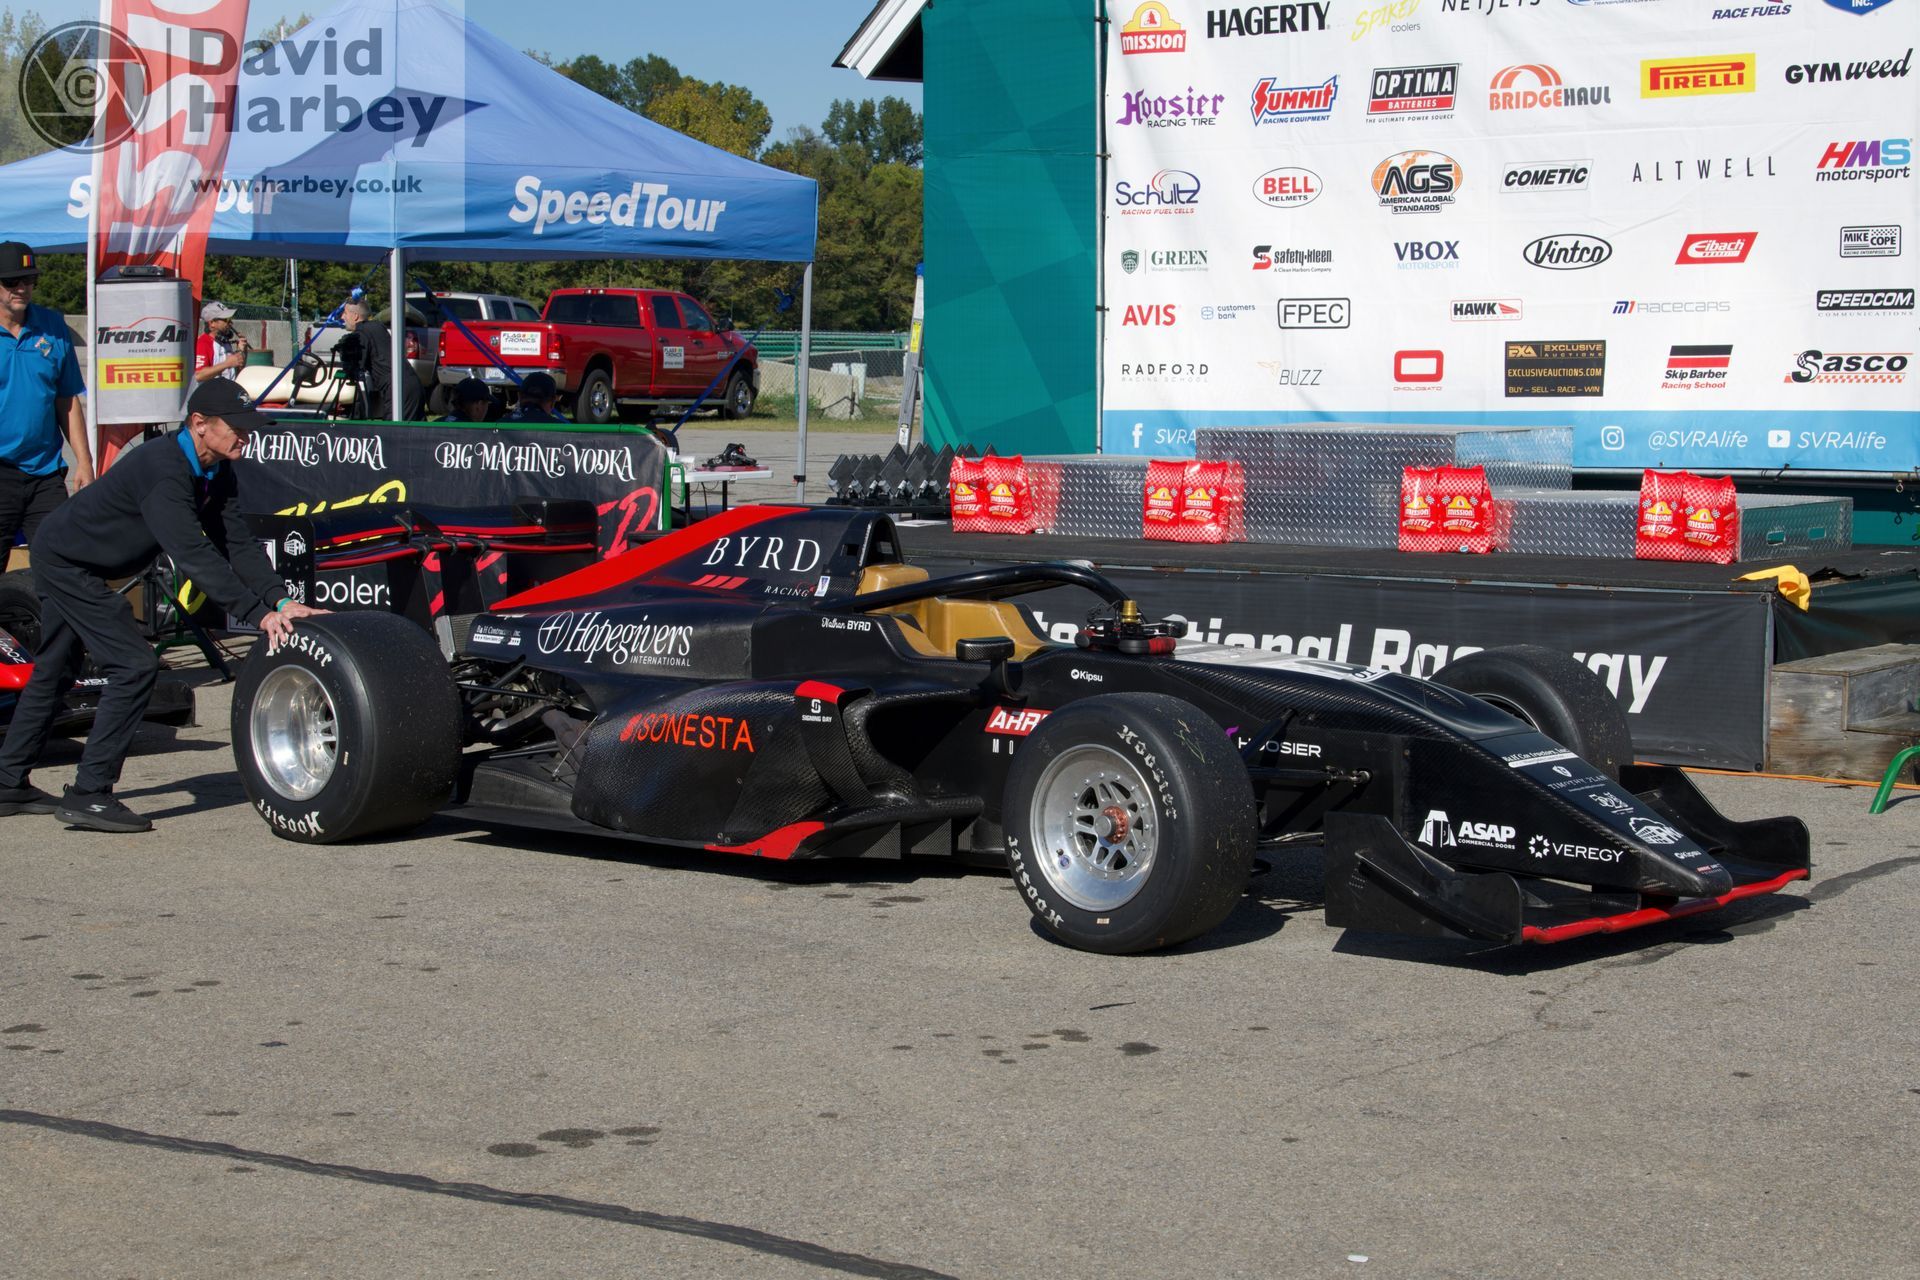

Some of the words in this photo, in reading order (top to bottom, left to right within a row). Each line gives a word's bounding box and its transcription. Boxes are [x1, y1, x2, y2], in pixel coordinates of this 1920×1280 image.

[1207, 1, 1331, 39] HAGERTY
[1712, 8, 1749, 20] RACE
[1751, 4, 1792, 18] FUELS
[1391, 23, 1421, 33] coolers
[1122, 33, 1185, 51] MISSION
[1785, 63, 1842, 85] GYM
[1846, 48, 1914, 81] weed
[1375, 71, 1452, 96] OPTIMA
[1650, 62, 1746, 90] PIRELLI
[1116, 86, 1225, 126] Hoosier
[1388, 99, 1437, 109] BATTERIES
[1489, 86, 1612, 111] BRIDGEHAUL
[1147, 118, 1187, 128] RACING
[1192, 117, 1217, 126] TIRE
[1263, 116, 1289, 124] RACING
[1290, 115, 1330, 123] EQUIPMENT
[1816, 138, 1911, 168] HMS
[1504, 167, 1588, 187] COMETIC
[1633, 156, 1776, 183] ALTWELL
[1816, 168, 1911, 183] motorsport
[1263, 176, 1314, 195] BELL
[1380, 163, 1454, 195] AGS
[1115, 180, 1201, 206] Schultz
[1268, 194, 1309, 202] HELMETS
[1381, 196, 1421, 205] AMERICAN
[1423, 195, 1453, 204] GLOBAL
[508, 175, 727, 235] SpeedTour
[1121, 208, 1151, 216] RACING
[1393, 204, 1440, 213] STANDARDS
[1686, 239, 1744, 258] Eibach
[1844, 233, 1869, 242] MIKE
[1870, 236, 1896, 246] COPE
[1151, 250, 1208, 265] GREEN
[1393, 240, 1460, 261] VBOX
[1534, 240, 1605, 265] Vintco
[1397, 261, 1460, 270] MOTORSPORT
[1217, 304, 1256, 312] customers
[1453, 302, 1498, 316] HAWK
[1818, 292, 1913, 308] SPEEDCOM
[1122, 304, 1177, 326] AVIS
[1217, 312, 1237, 320] bank
[1283, 303, 1344, 324] FPEC
[97, 327, 156, 345] Trans
[1544, 343, 1604, 351] EXCLUSIVE
[1122, 364, 1209, 376] RADFORD
[1508, 368, 1603, 377] EXCLUSIVEAUCTIONS.COM
[1665, 370, 1688, 381] Skip
[1690, 369, 1728, 379] Barber
[1791, 350, 1908, 383] Sasco
[1279, 369, 1323, 386] BUZZ
[1661, 382, 1692, 390] Racing
[1557, 385, 1576, 393] RACE
[1155, 429, 1196, 444] SVRA
[1648, 430, 1749, 449] @SVRAlife
[1797, 431, 1886, 450] SVRAlife
[318, 432, 388, 471] VODKA
[435, 441, 473, 470] BIG
[474, 441, 565, 479] MACHINE
[564, 443, 637, 482] VODKA
[702, 536, 821, 572] BYRD
[315, 575, 391, 606] ooler
[764, 585, 810, 597] RACING
[847, 620, 872, 632] BYRD
[564, 611, 693, 665] Hopegivers
[630, 655, 691, 667] INTERNATIONAL
[1079, 671, 1103, 682] Kipsu
[802, 714, 822, 723] SIGNING
[822, 715, 833, 723] DAY
[636, 713, 756, 752] SONESTA
[1238, 736, 1322, 758] HOSIER
[1458, 821, 1516, 843] ASAP
[1458, 838, 1494, 848] COMMERCIAL
[1552, 842, 1624, 863] VEREGY
